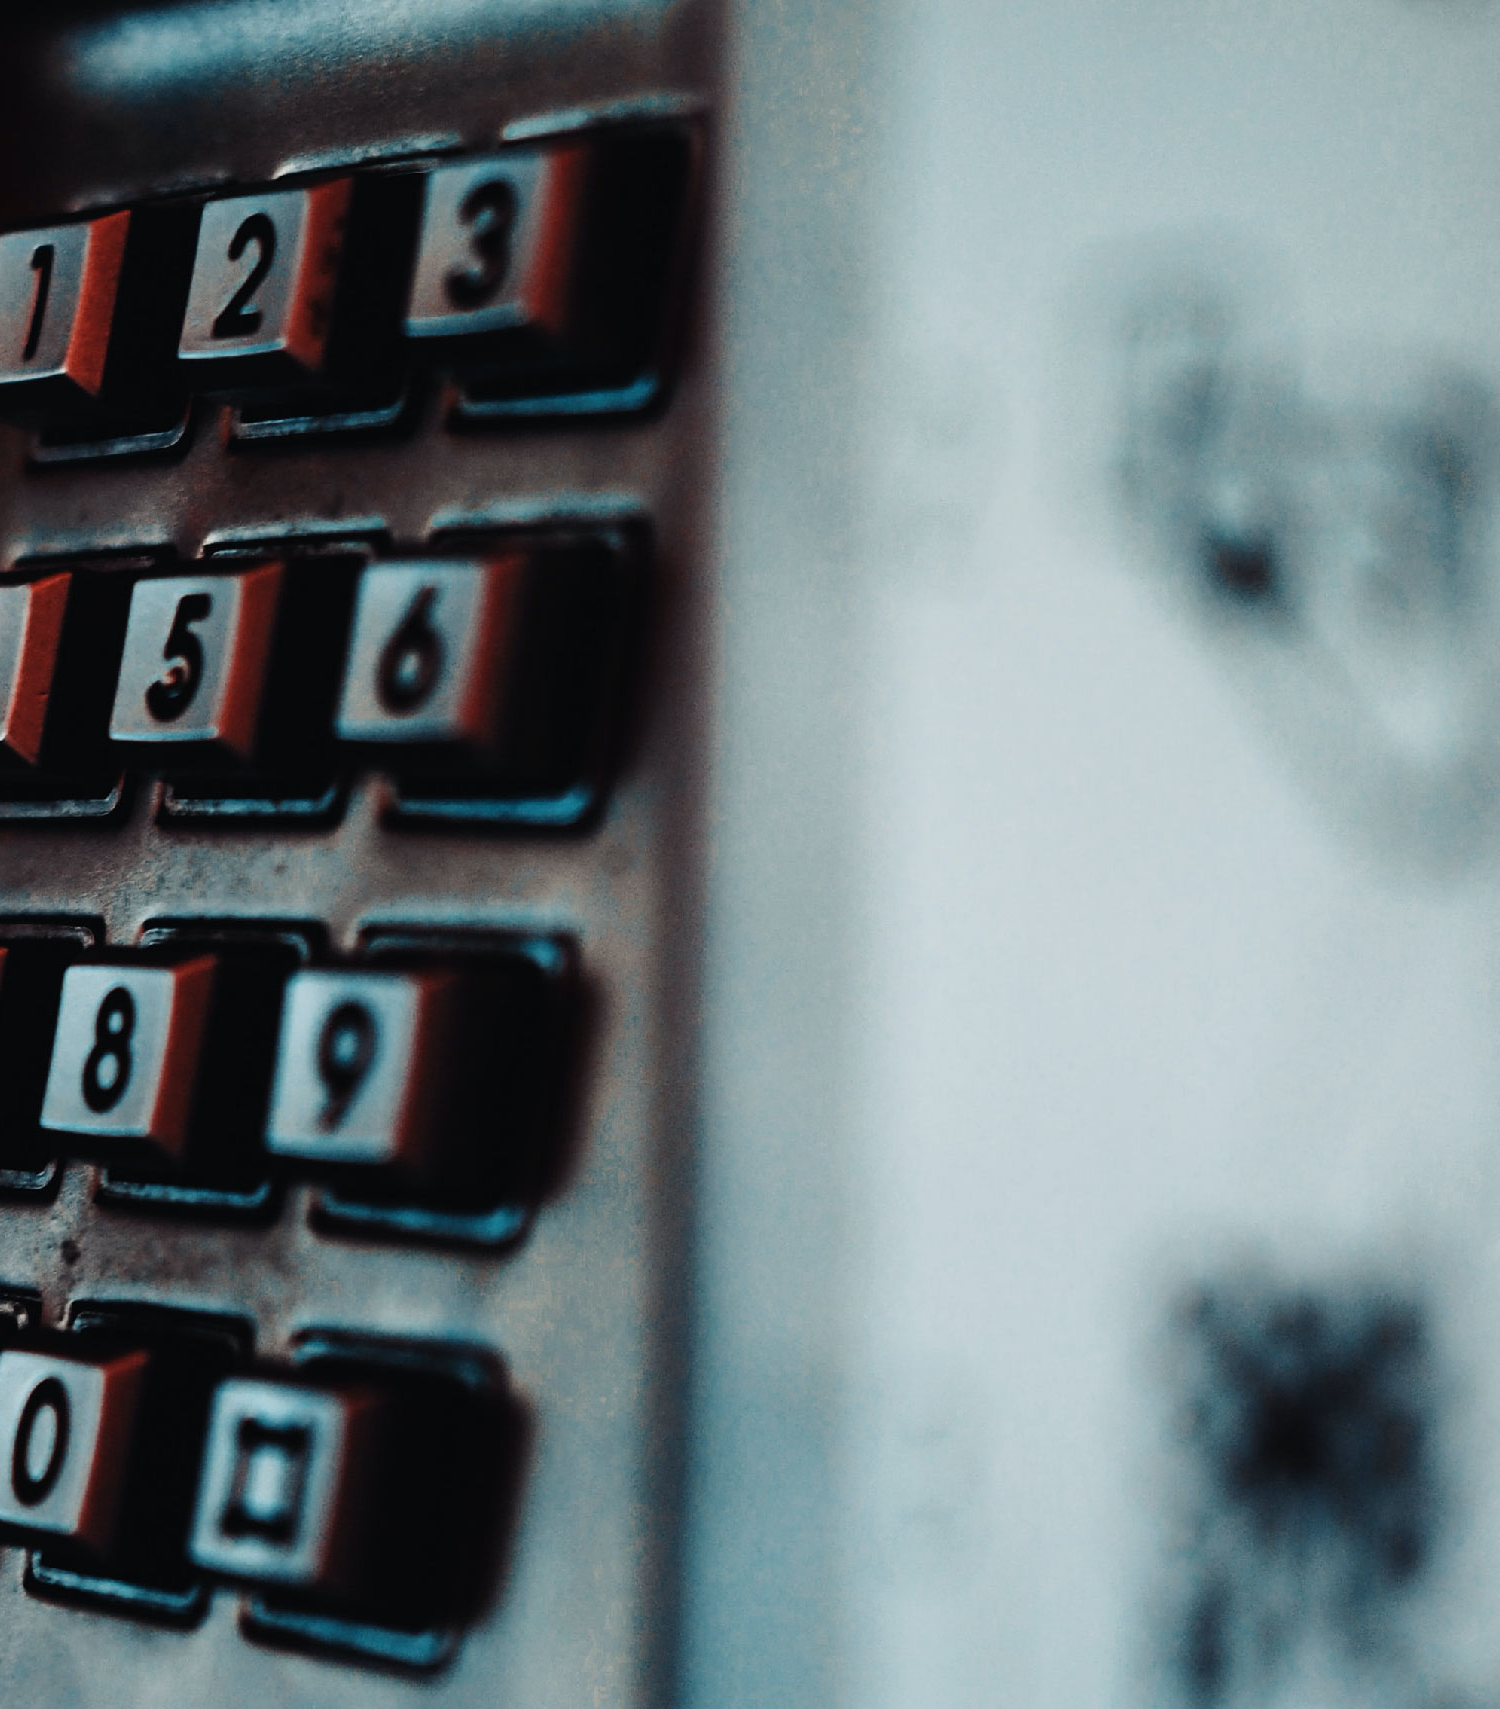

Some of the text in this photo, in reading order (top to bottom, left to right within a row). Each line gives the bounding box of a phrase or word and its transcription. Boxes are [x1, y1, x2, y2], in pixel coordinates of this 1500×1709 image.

[23, 178, 518, 360] 1 2 3
[145, 594, 212, 721] 5
[378, 585, 446, 717] 6
[83, 986, 136, 1113] 8
[318, 1001, 376, 1136] 9
[10, 1376, 70, 1506] 0
